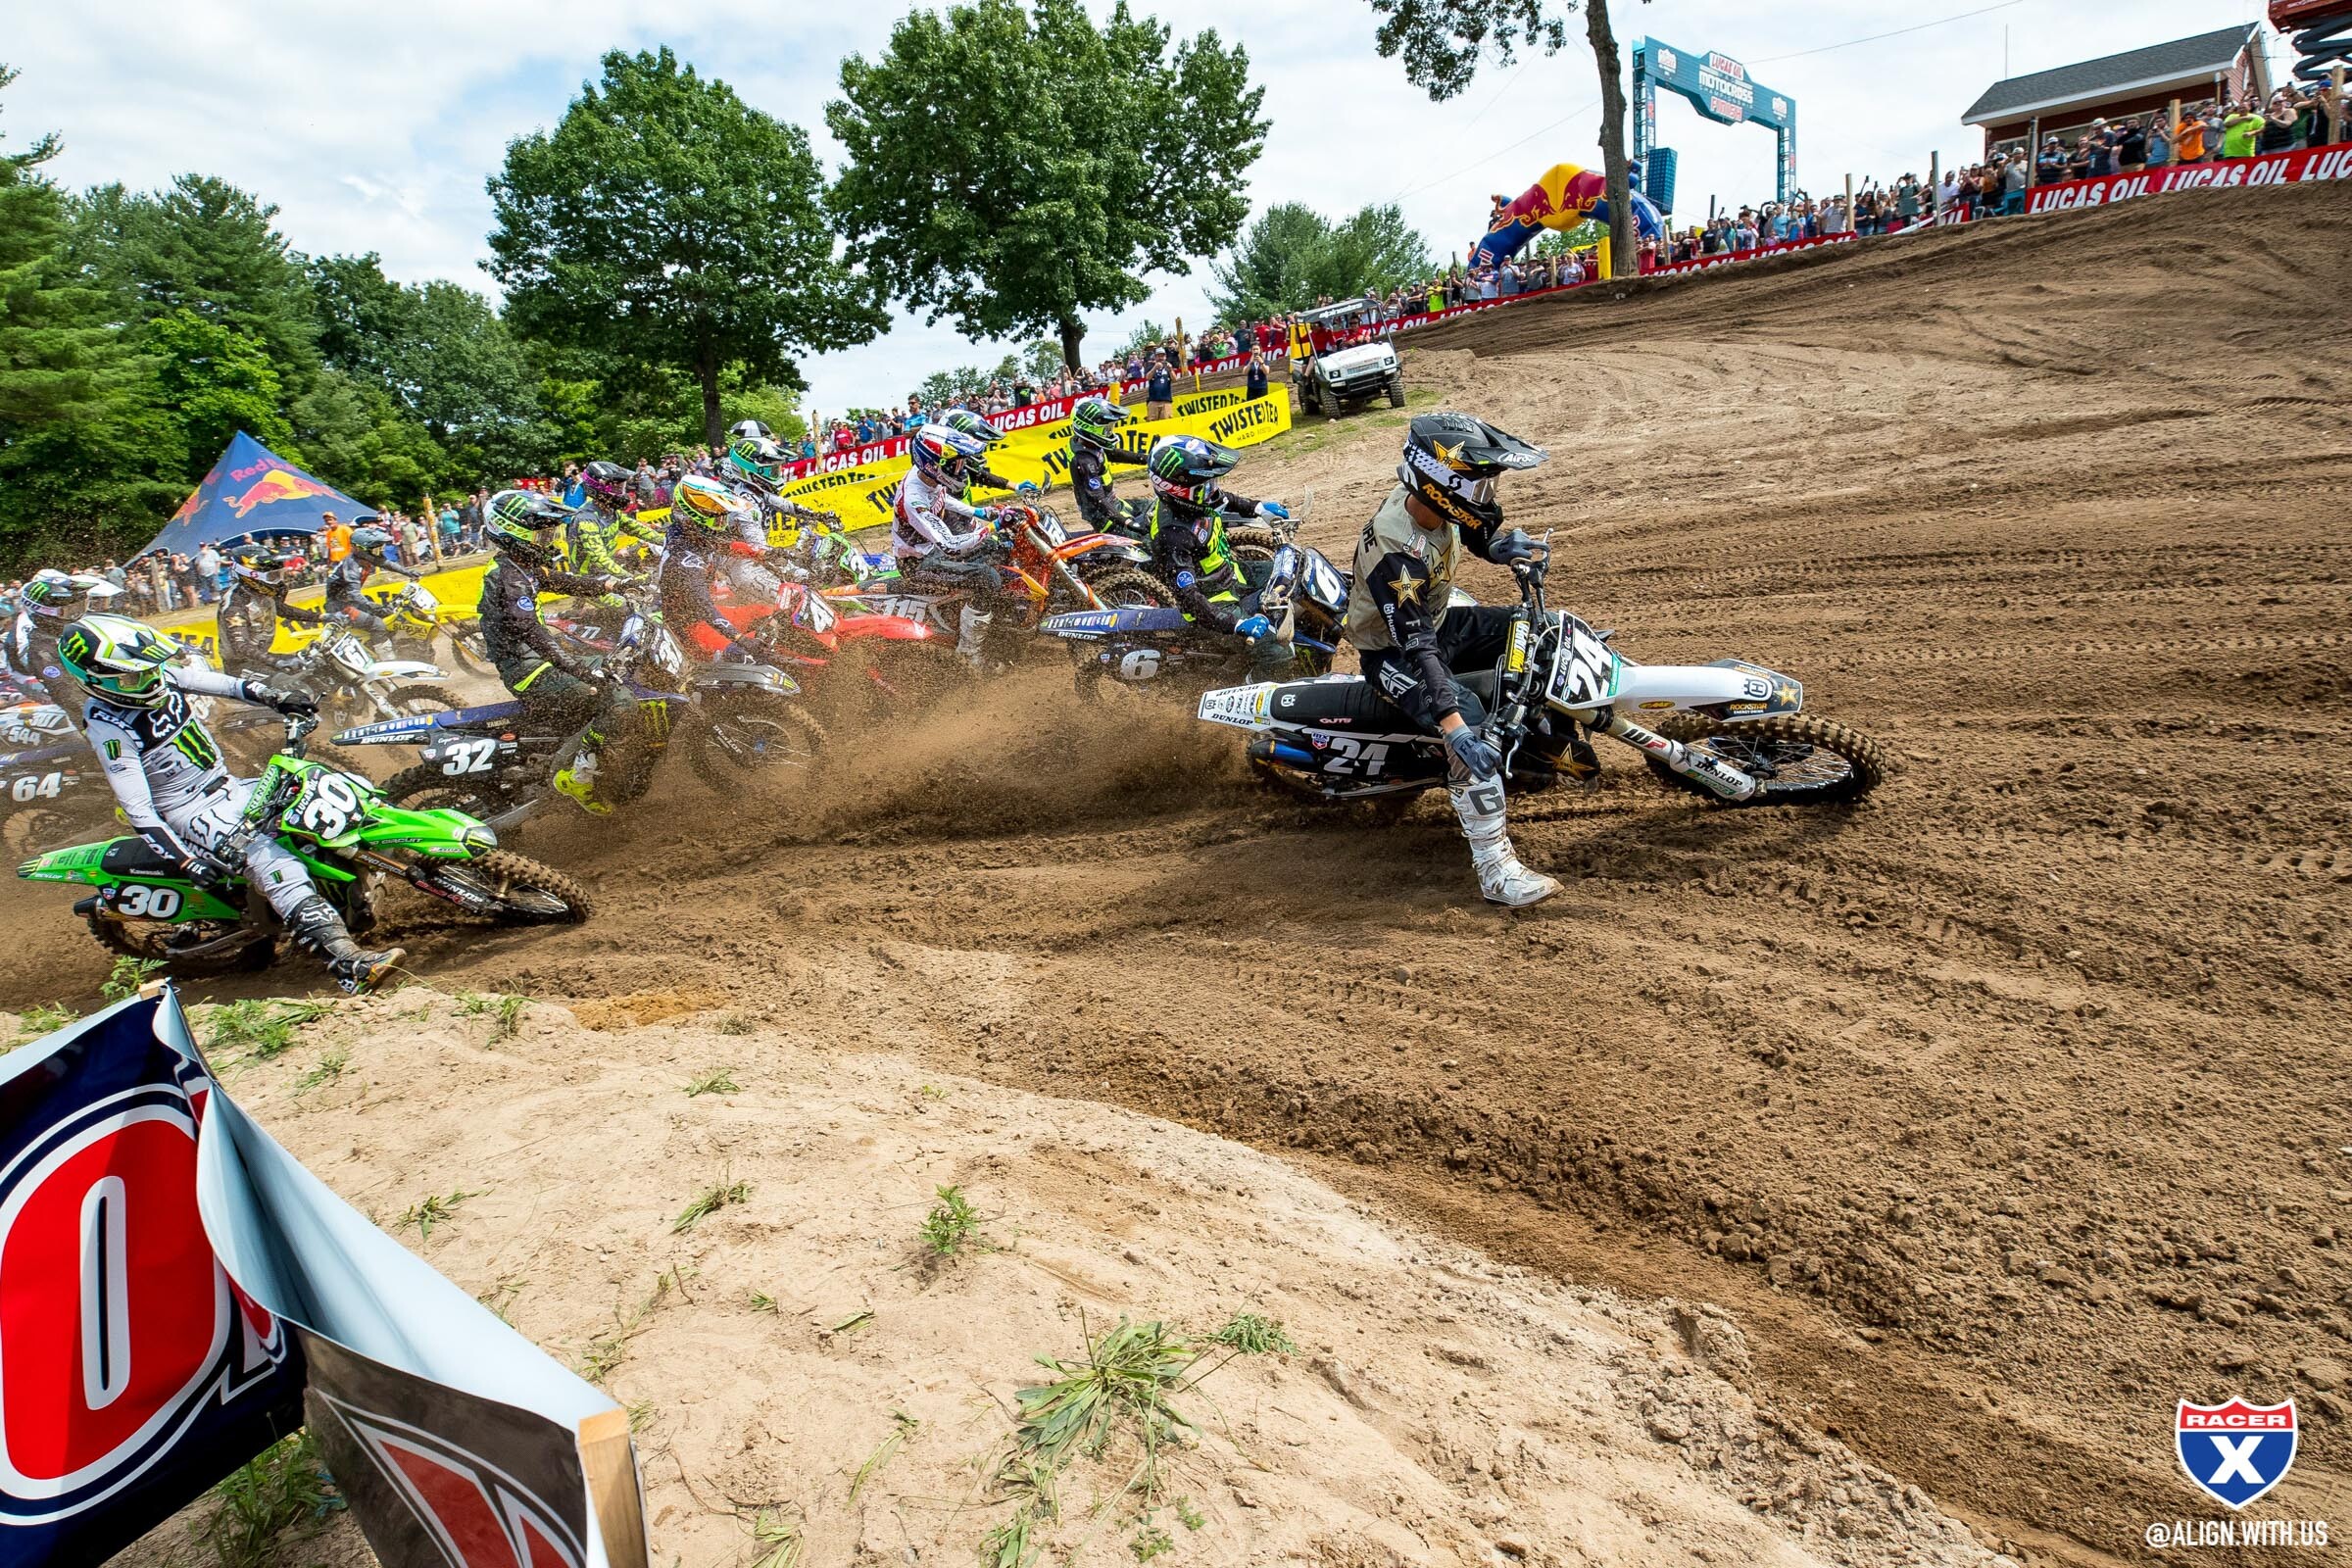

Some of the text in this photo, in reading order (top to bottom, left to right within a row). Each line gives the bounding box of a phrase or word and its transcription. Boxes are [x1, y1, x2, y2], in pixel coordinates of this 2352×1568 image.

[1711, 54, 1733, 74] LUCAS
[1699, 71, 1753, 104] MOTOCROSS
[2029, 182, 2107, 214] LUCAS
[2108, 175, 2151, 203] OIL
[2160, 164, 2246, 193] LUCAS
[2246, 158, 2290, 186] OIL
[1040, 401, 1065, 422] OIL
[1176, 394, 1228, 416] TWISTED
[1208, 402, 1266, 443] TWISTED
[861, 444, 888, 465] OIL
[230, 458, 269, 482] Red
[1422, 482, 1483, 530] ROCKSTAR
[1315, 554, 1342, 606] 6
[1057, 631, 1098, 641] DUNLOP
[1120, 649, 1161, 680] 6
[1568, 627, 1613, 701] 24
[92, 709, 133, 730] FOX
[1211, 713, 1254, 726] DUNLOP
[8, 725, 41, 746] 544
[360, 734, 416, 745] DUNLOP
[712, 724, 743, 755] DUNLOP
[442, 738, 497, 776] 32
[1323, 737, 1390, 776] 24
[12, 771, 62, 802] 64
[1694, 760, 1743, 787] DUNLOP
[295, 790, 315, 815] LUCAS
[303, 773, 358, 840] 30
[186, 861, 208, 875] FOX
[118, 884, 181, 918] 30
